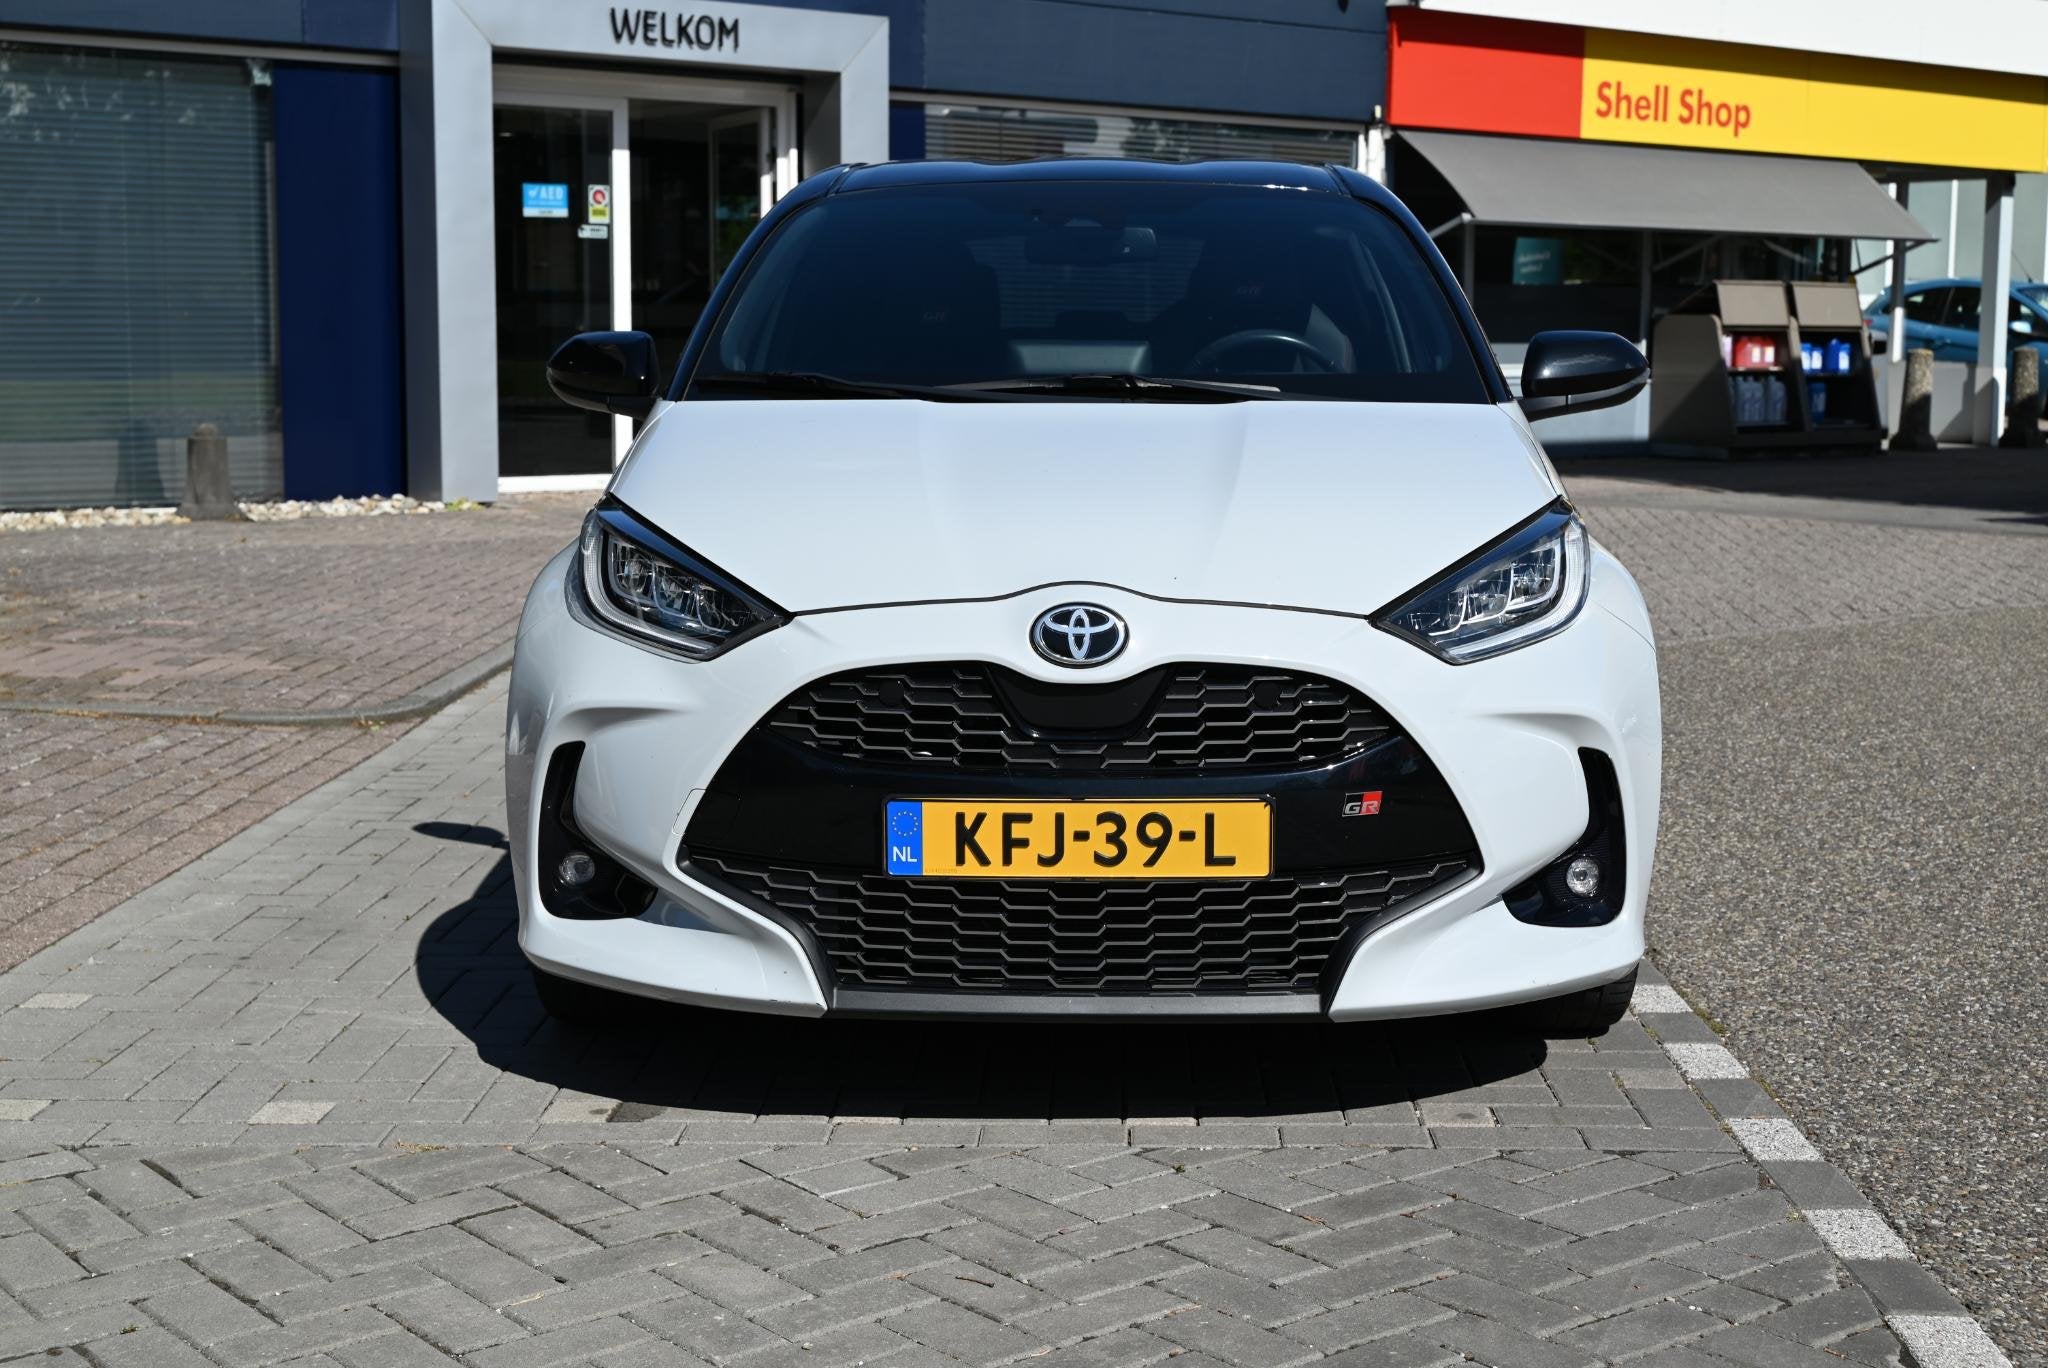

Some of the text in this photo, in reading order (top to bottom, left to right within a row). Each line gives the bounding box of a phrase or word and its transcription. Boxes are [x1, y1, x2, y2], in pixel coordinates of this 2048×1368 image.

[610, 7, 739, 53] WELKOM
[1596, 81, 1751, 137] Shell Shop
[540, 186, 564, 200] AED
[1345, 800, 1379, 814] GR
[893, 846, 917, 862] NL
[955, 811, 1236, 868] KFJ-39-L
